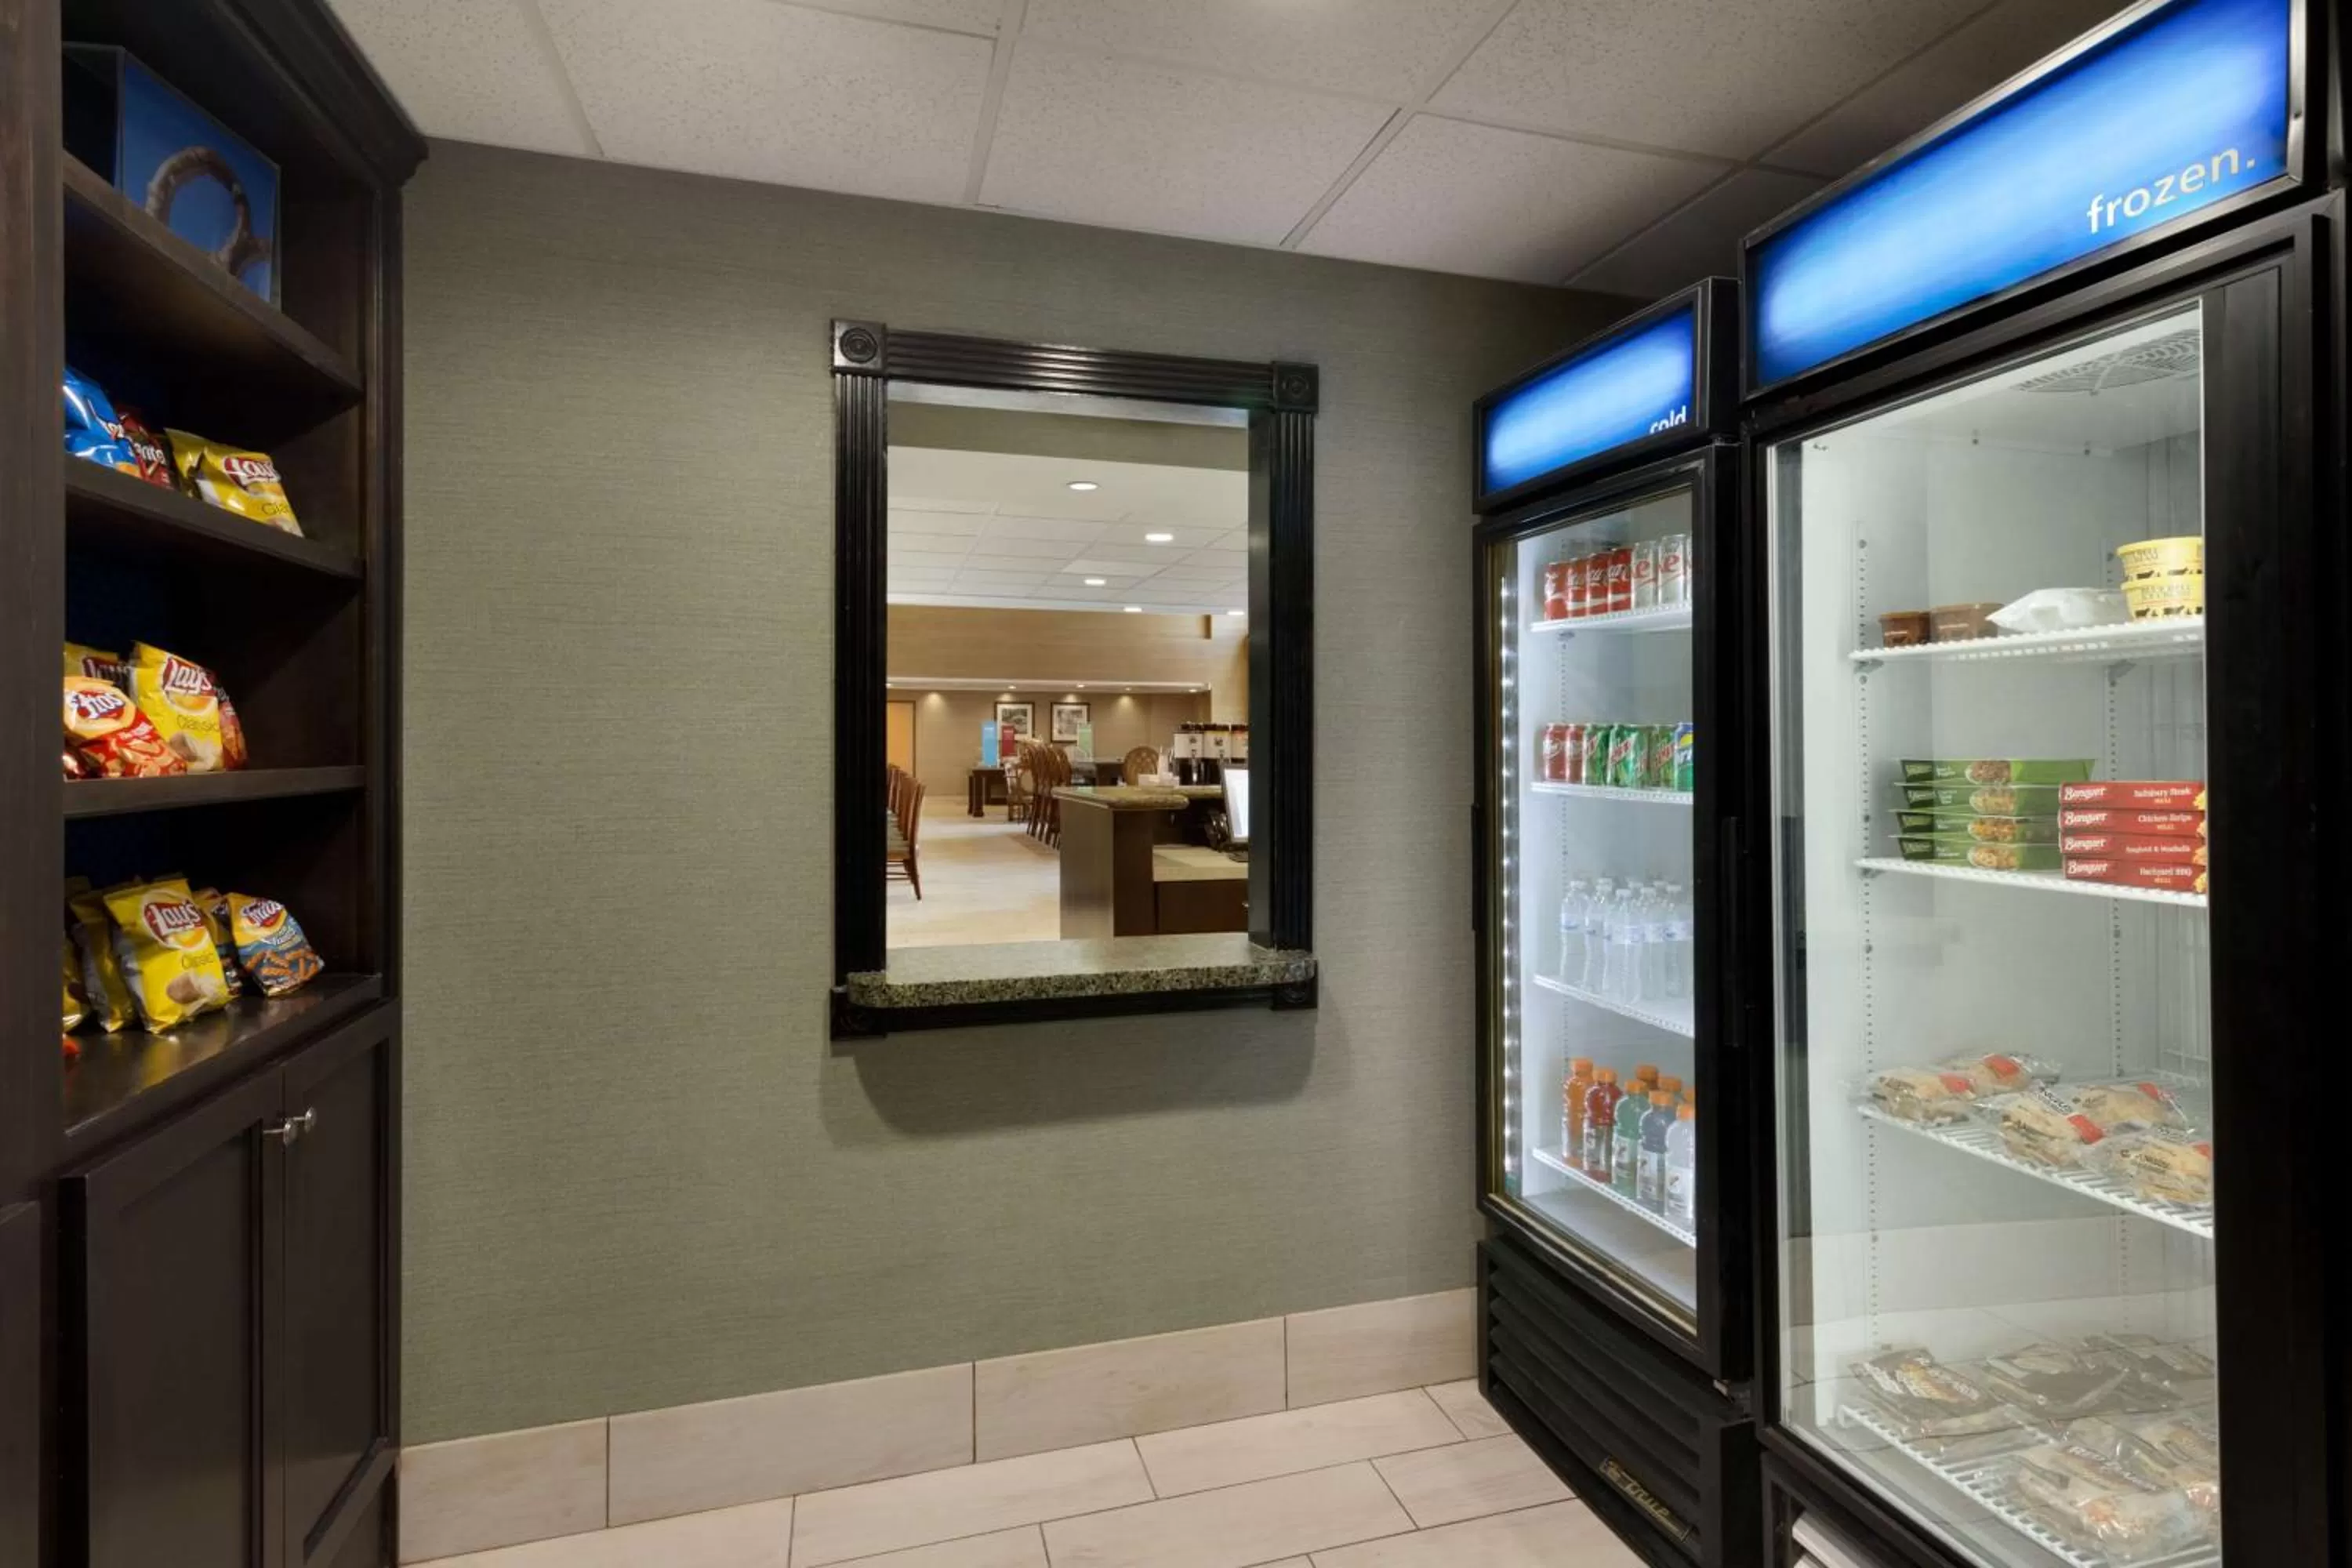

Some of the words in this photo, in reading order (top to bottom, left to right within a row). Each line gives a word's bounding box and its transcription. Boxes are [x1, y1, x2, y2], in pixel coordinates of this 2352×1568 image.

[2086, 147, 2256, 234] frozen.
[164, 657, 212, 695] Lay's
[147, 902, 201, 936] Lay's
